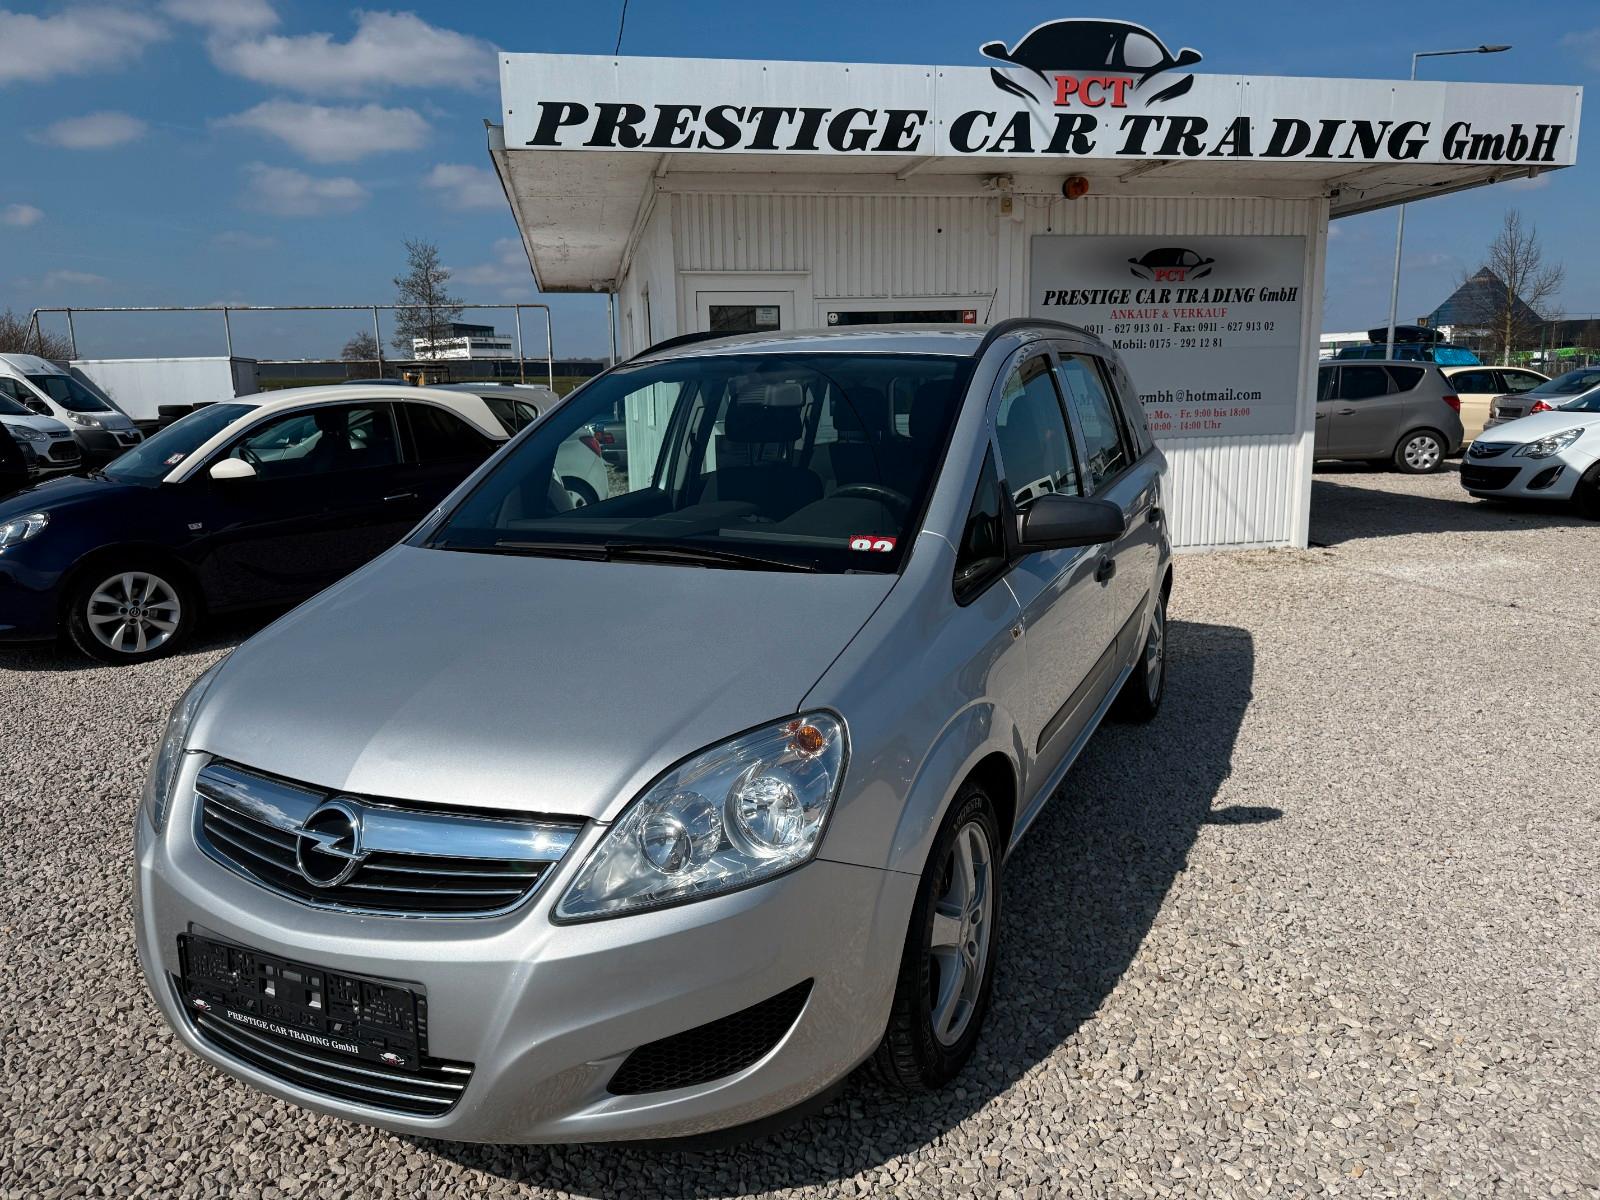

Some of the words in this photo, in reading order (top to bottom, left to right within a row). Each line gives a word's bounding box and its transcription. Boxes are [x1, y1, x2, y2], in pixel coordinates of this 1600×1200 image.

[1053, 75, 1133, 108] PCT
[526, 101, 928, 153] PRESTIGE
[949, 110, 1098, 154] CAR
[1115, 114, 1431, 160] TRADING
[1442, 121, 1565, 162] GmbH
[1154, 268, 1185, 282] PCT
[1042, 289, 1131, 306] PRESTIGE
[1135, 288, 1171, 305] CAR
[1176, 287, 1255, 303] TRADING
[1259, 286, 1298, 303] GmbH
[1110, 308, 1160, 320] ANKAUF
[1161, 310, 1169, 319] &
[1172, 307, 1228, 319] VERKAUF
[1114, 323, 1131, 334] 627
[1134, 323, 1150, 333] 913
[1153, 323, 1163, 333] 01
[1173, 322, 1196, 333] Fax:
[1198, 322, 1217, 333] 0911
[1227, 321, 1244, 332] 627
[1246, 321, 1261, 332] 913
[1264, 321, 1275, 332] 02
[1112, 339, 1147, 350] Mobil:
[1149, 339, 1171, 349] 0175
[1180, 338, 1196, 348] 292
[1200, 338, 1210, 348] 12
[1212, 337, 1222, 348] 81
[1154, 410, 1172, 419] Mo.
[1180, 408, 1192, 419] Fr.
[1194, 408, 1211, 418] 9:00
[1213, 407, 1227, 417] bis
[1229, 407, 1250, 417] 18:00
[1150, 422, 1171, 431] 10:00
[1180, 421, 1201, 430] 14:00
[1204, 420, 1222, 430] Uhr
[226, 1010, 269, 1030] PRESTIGE
[269, 1023, 288, 1036] CAR
[288, 1029, 330, 1047] TRADING
[331, 1040, 359, 1054] GmbH
